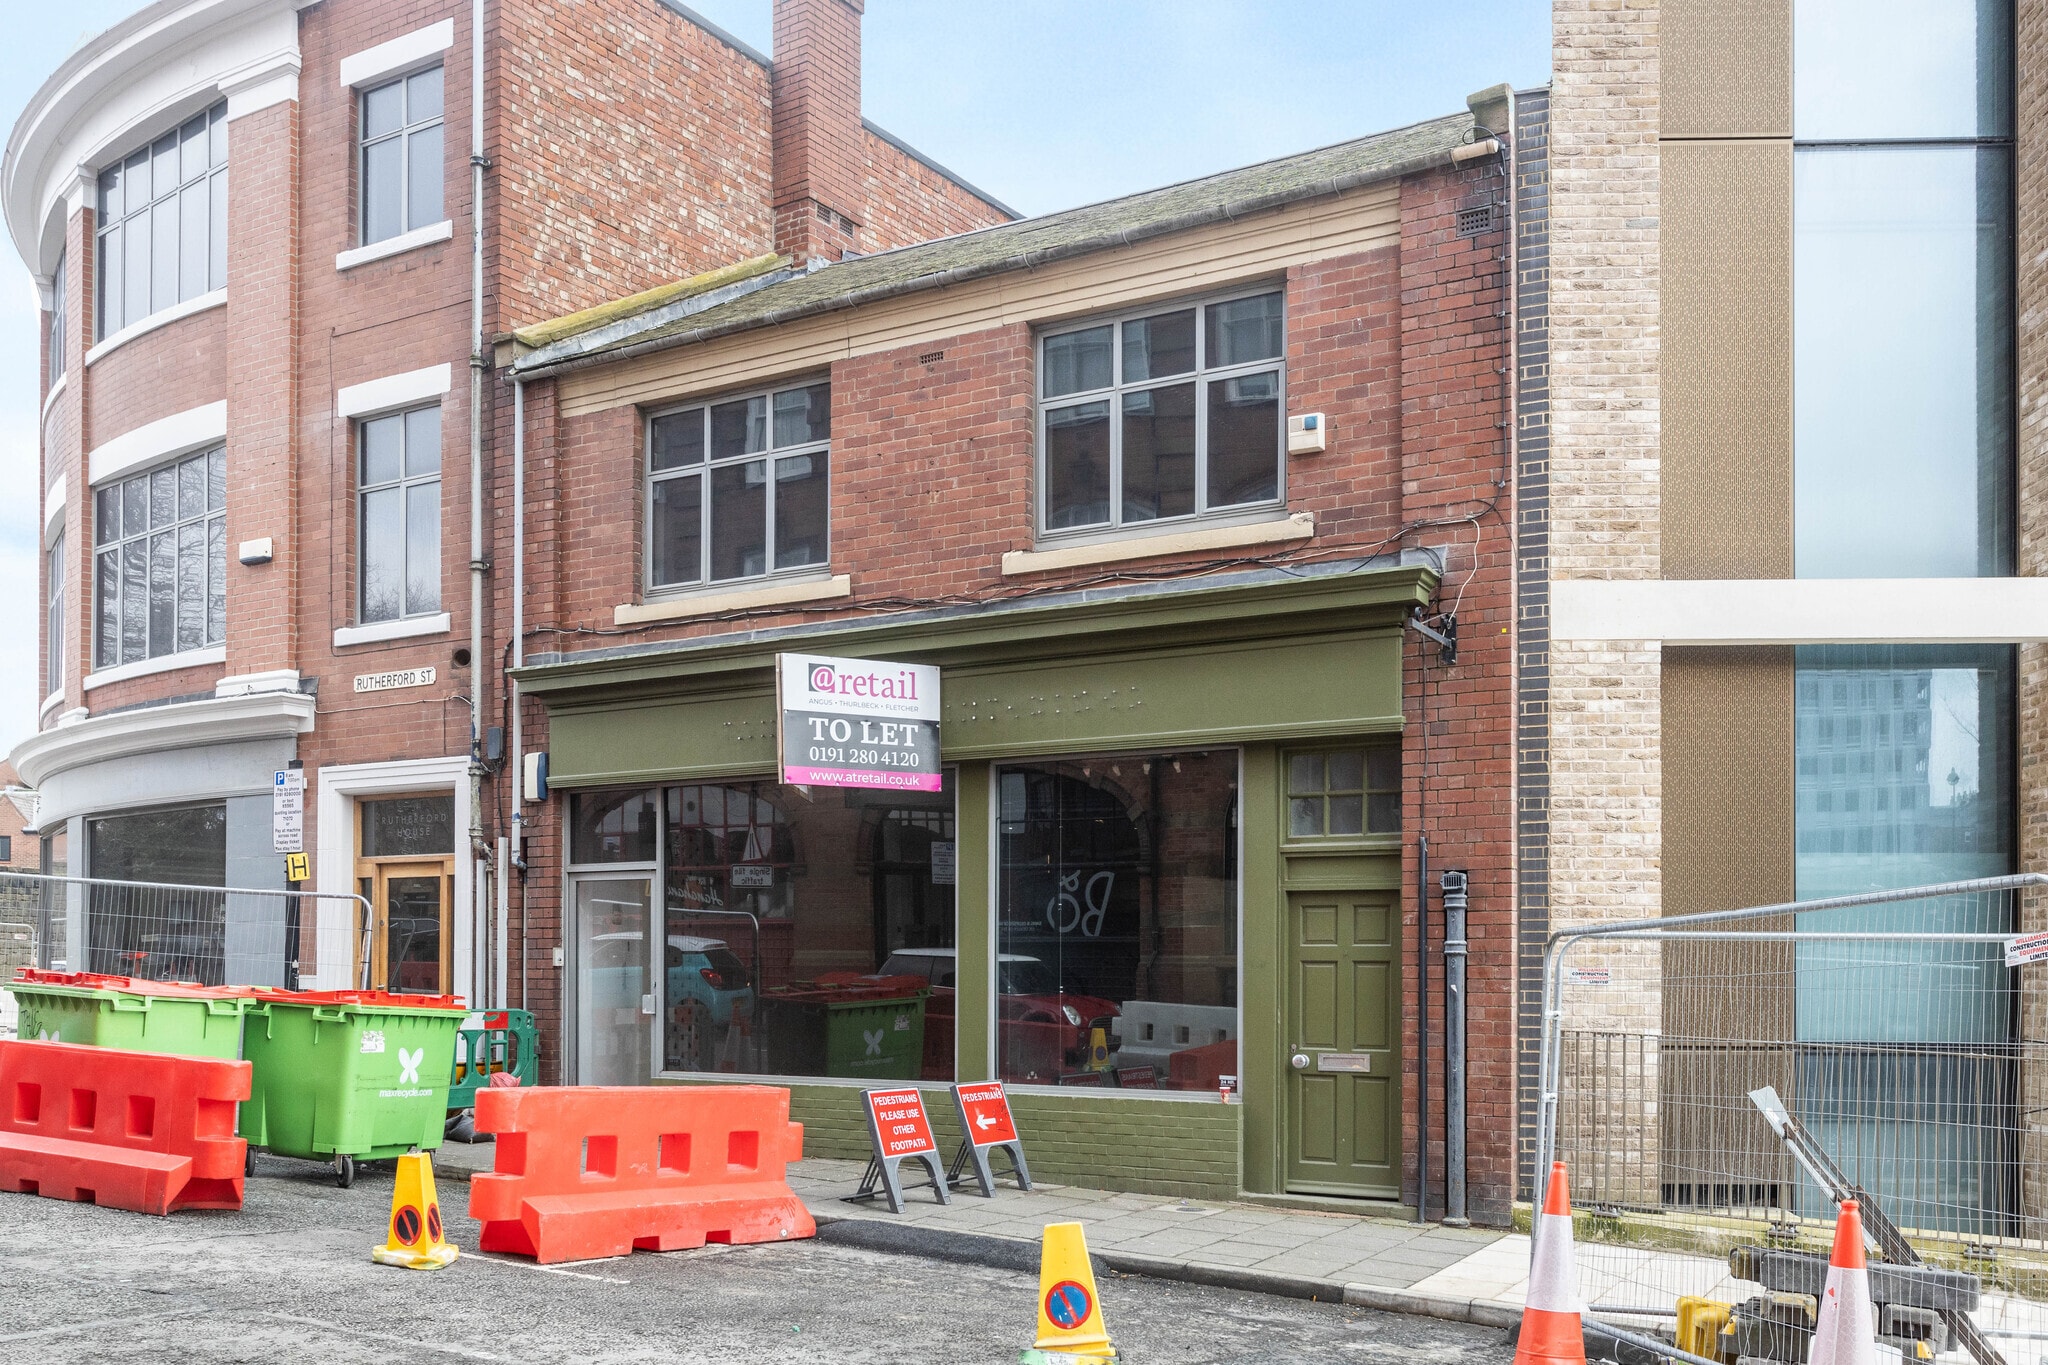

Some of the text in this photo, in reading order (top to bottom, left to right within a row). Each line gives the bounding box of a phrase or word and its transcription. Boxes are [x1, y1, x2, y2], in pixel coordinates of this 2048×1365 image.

[356, 672, 416, 691] RUTHERFORD
[810, 664, 918, 700] @retail
[809, 698, 919, 713] ANGUS THURLBECK FLETCHER
[808, 717, 919, 747] TO LET
[809, 746, 919, 767] 0191 280 4120
[809, 771, 920, 786] www.atretail.co.uk
[381, 813, 447, 825] RUTHERFORD
[397, 826, 431, 838] HOUSE
[291, 855, 308, 878] H
[2010, 939, 2048, 952] CONSTRUCTIO
[2019, 946, 2048, 956] EQUIPMEN
[2029, 952, 2048, 961] LIMITE
[379, 1088, 432, 1098] maxrecycle.com
[873, 1093, 918, 1106] PEDESTRIANS
[962, 1091, 1003, 1102] PEDESTRIANS
[879, 1108, 920, 1121] PLEASE USE
[892, 1124, 916, 1135] OTHER
[890, 1138, 927, 1151] FOOTPATH
